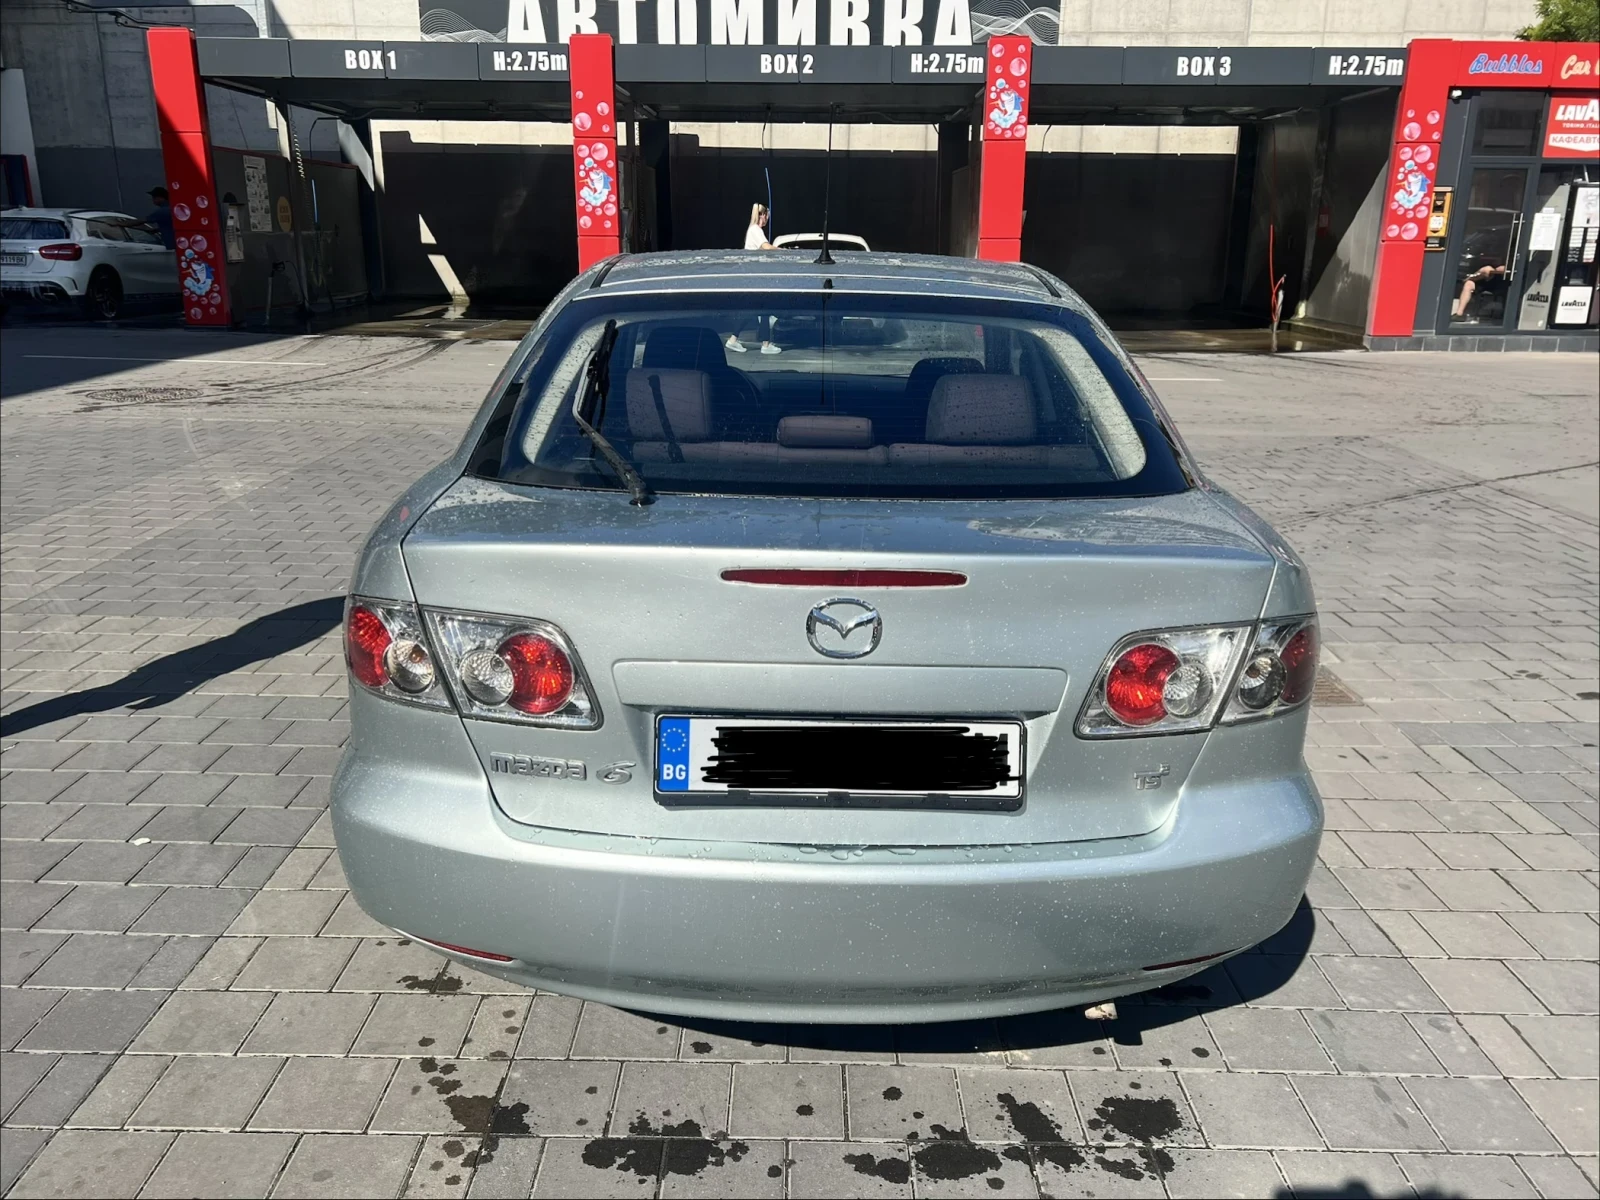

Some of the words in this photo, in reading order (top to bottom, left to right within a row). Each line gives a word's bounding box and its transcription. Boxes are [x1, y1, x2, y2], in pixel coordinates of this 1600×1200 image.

[344, 49, 385, 70] BOX
[386, 50, 397, 70] 1
[493, 50, 568, 71] H:2.75m
[760, 53, 798, 74] BOX
[802, 53, 814, 74] 2
[910, 53, 984, 74] H:2.75m
[1176, 56, 1215, 76] BOX
[1219, 56, 1232, 76] 3
[1328, 55, 1405, 76] H:2.75m
[1468, 53, 1543, 75] Bubbles
[1560, 54, 1592, 80] Car
[595, 760, 637, 786] 6
[662, 763, 687, 781] BG
